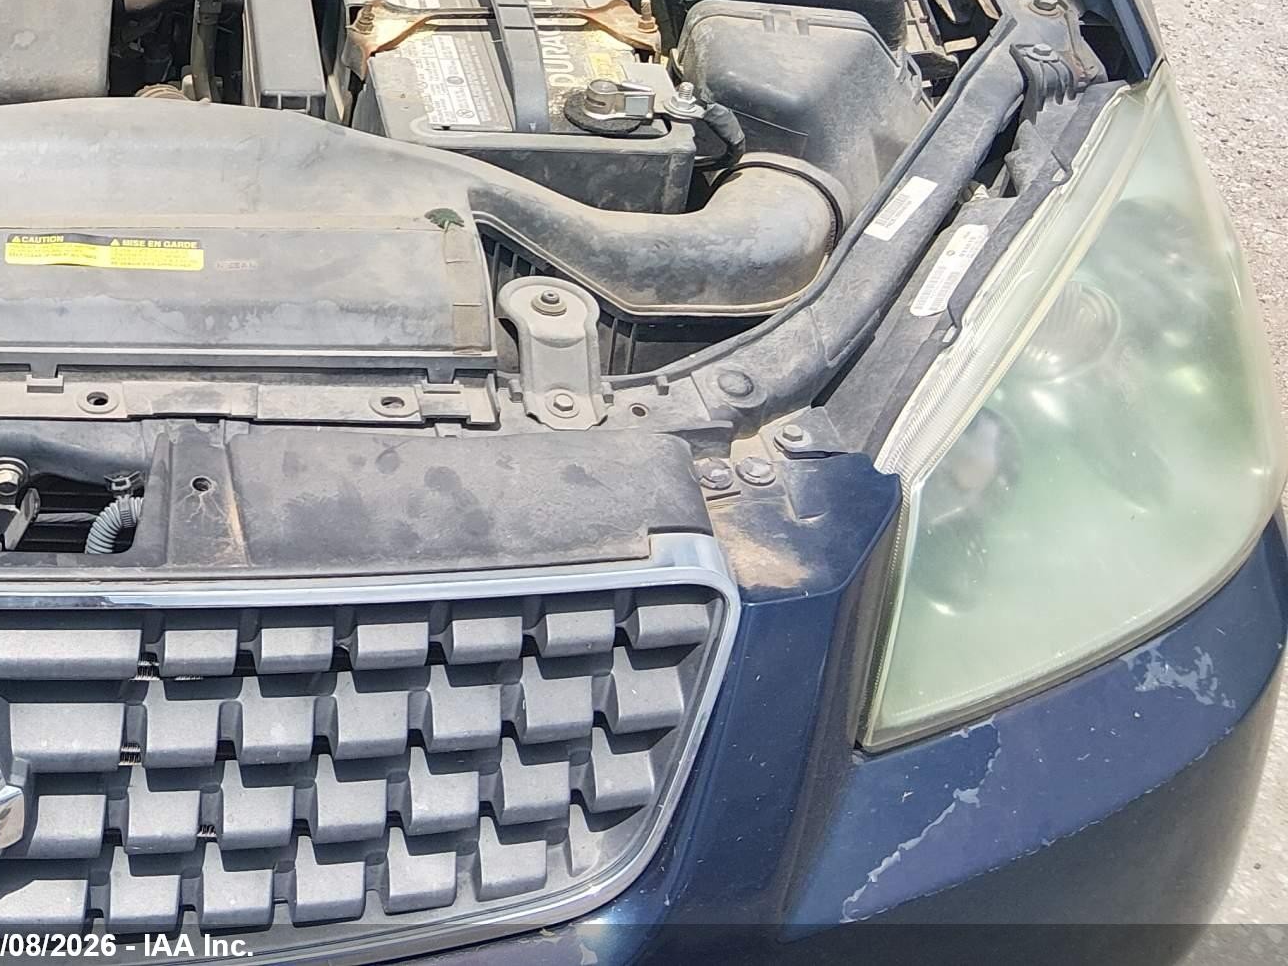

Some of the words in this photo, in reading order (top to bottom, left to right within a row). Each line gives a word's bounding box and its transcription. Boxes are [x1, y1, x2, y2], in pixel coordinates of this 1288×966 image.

[21, 235, 65, 244] CAUTION
[121, 239, 146, 247] MISE
[147, 240, 162, 248] EN
[163, 240, 198, 249] GARDE
